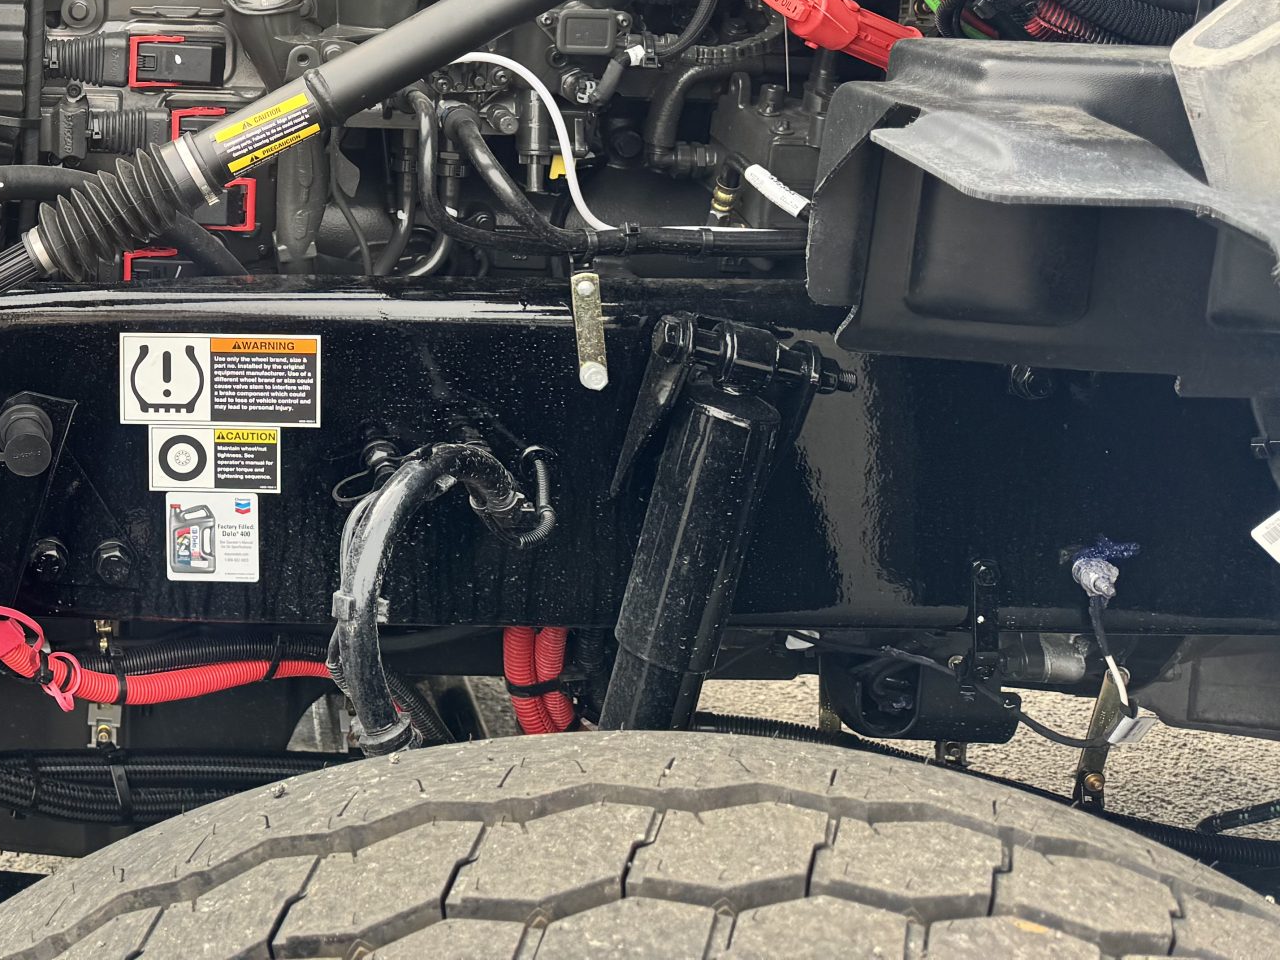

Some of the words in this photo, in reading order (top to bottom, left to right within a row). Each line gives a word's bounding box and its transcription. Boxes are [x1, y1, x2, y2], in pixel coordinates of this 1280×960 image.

[781, 0, 791, 11] OIL
[253, 107, 282, 124] CAUTION
[242, 342, 295, 351] WARNING
[226, 432, 275, 441] CAUTION
